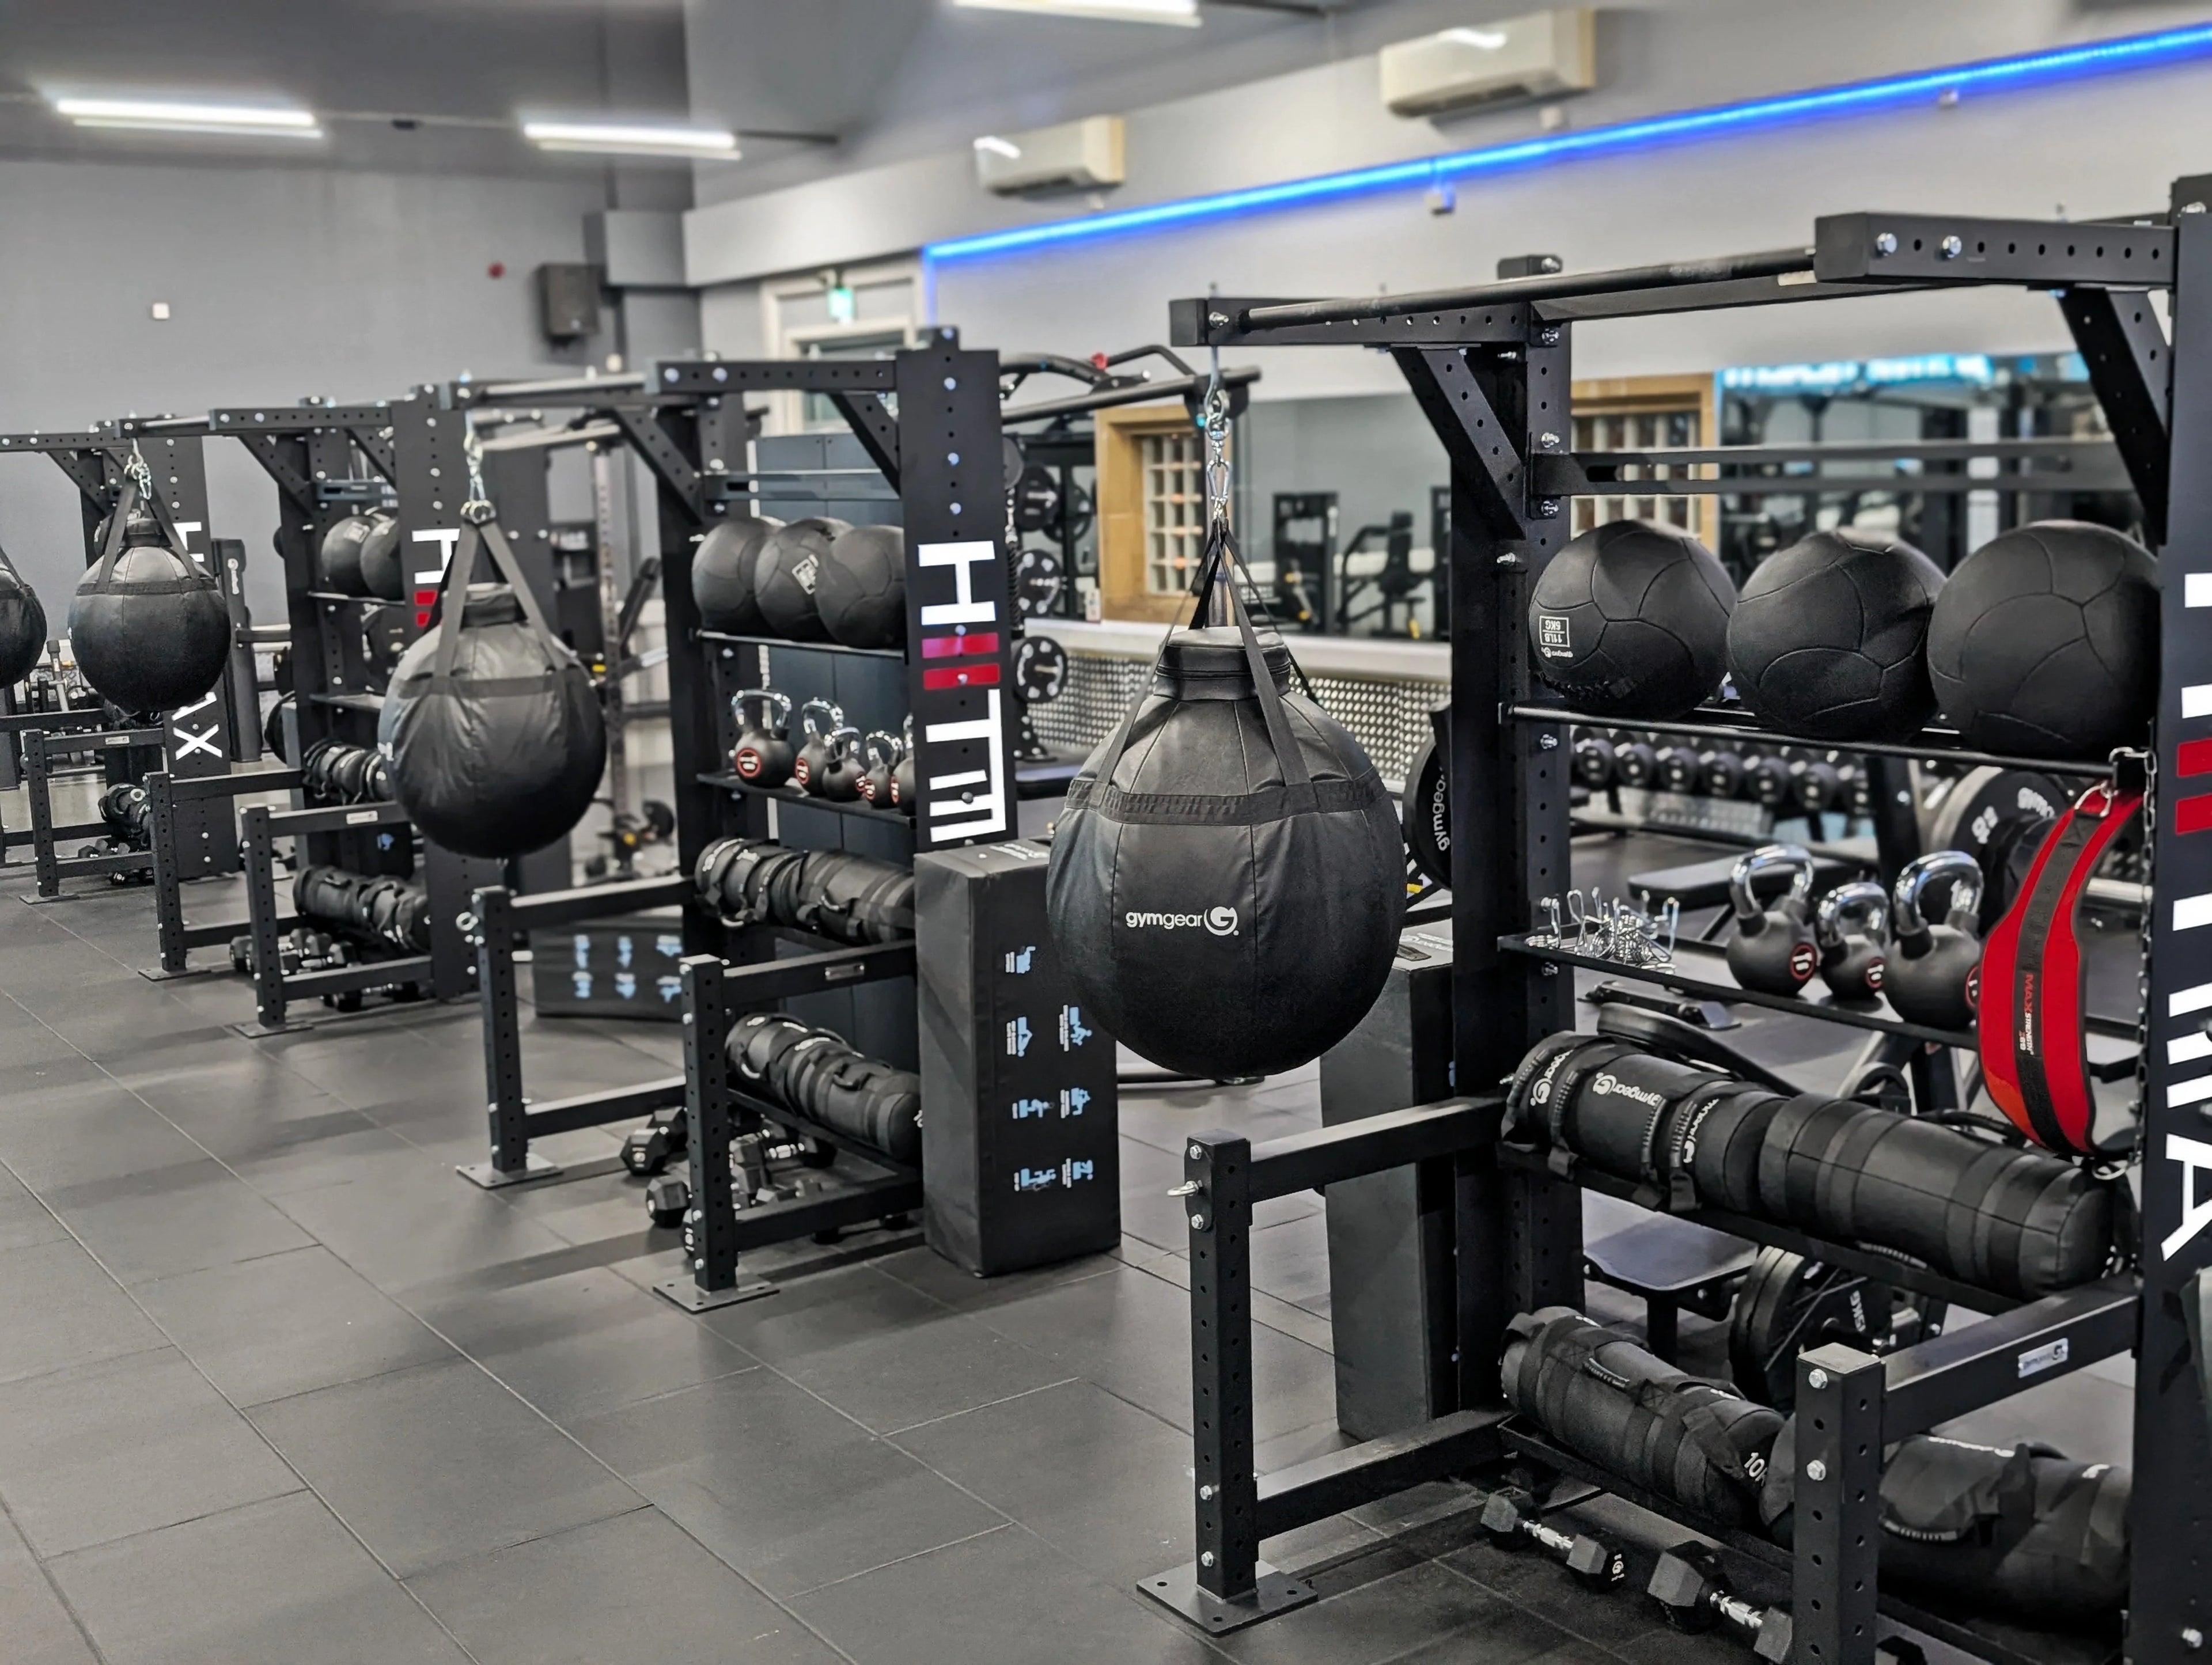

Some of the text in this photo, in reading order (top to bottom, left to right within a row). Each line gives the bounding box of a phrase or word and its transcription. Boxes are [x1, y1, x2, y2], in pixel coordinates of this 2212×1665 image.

[1544, 633, 1563, 643] 11LB
[1432, 774, 1450, 851] gymgea
[1125, 911, 1203, 930] gymgear
[1744, 1452, 1768, 1487] 10K
